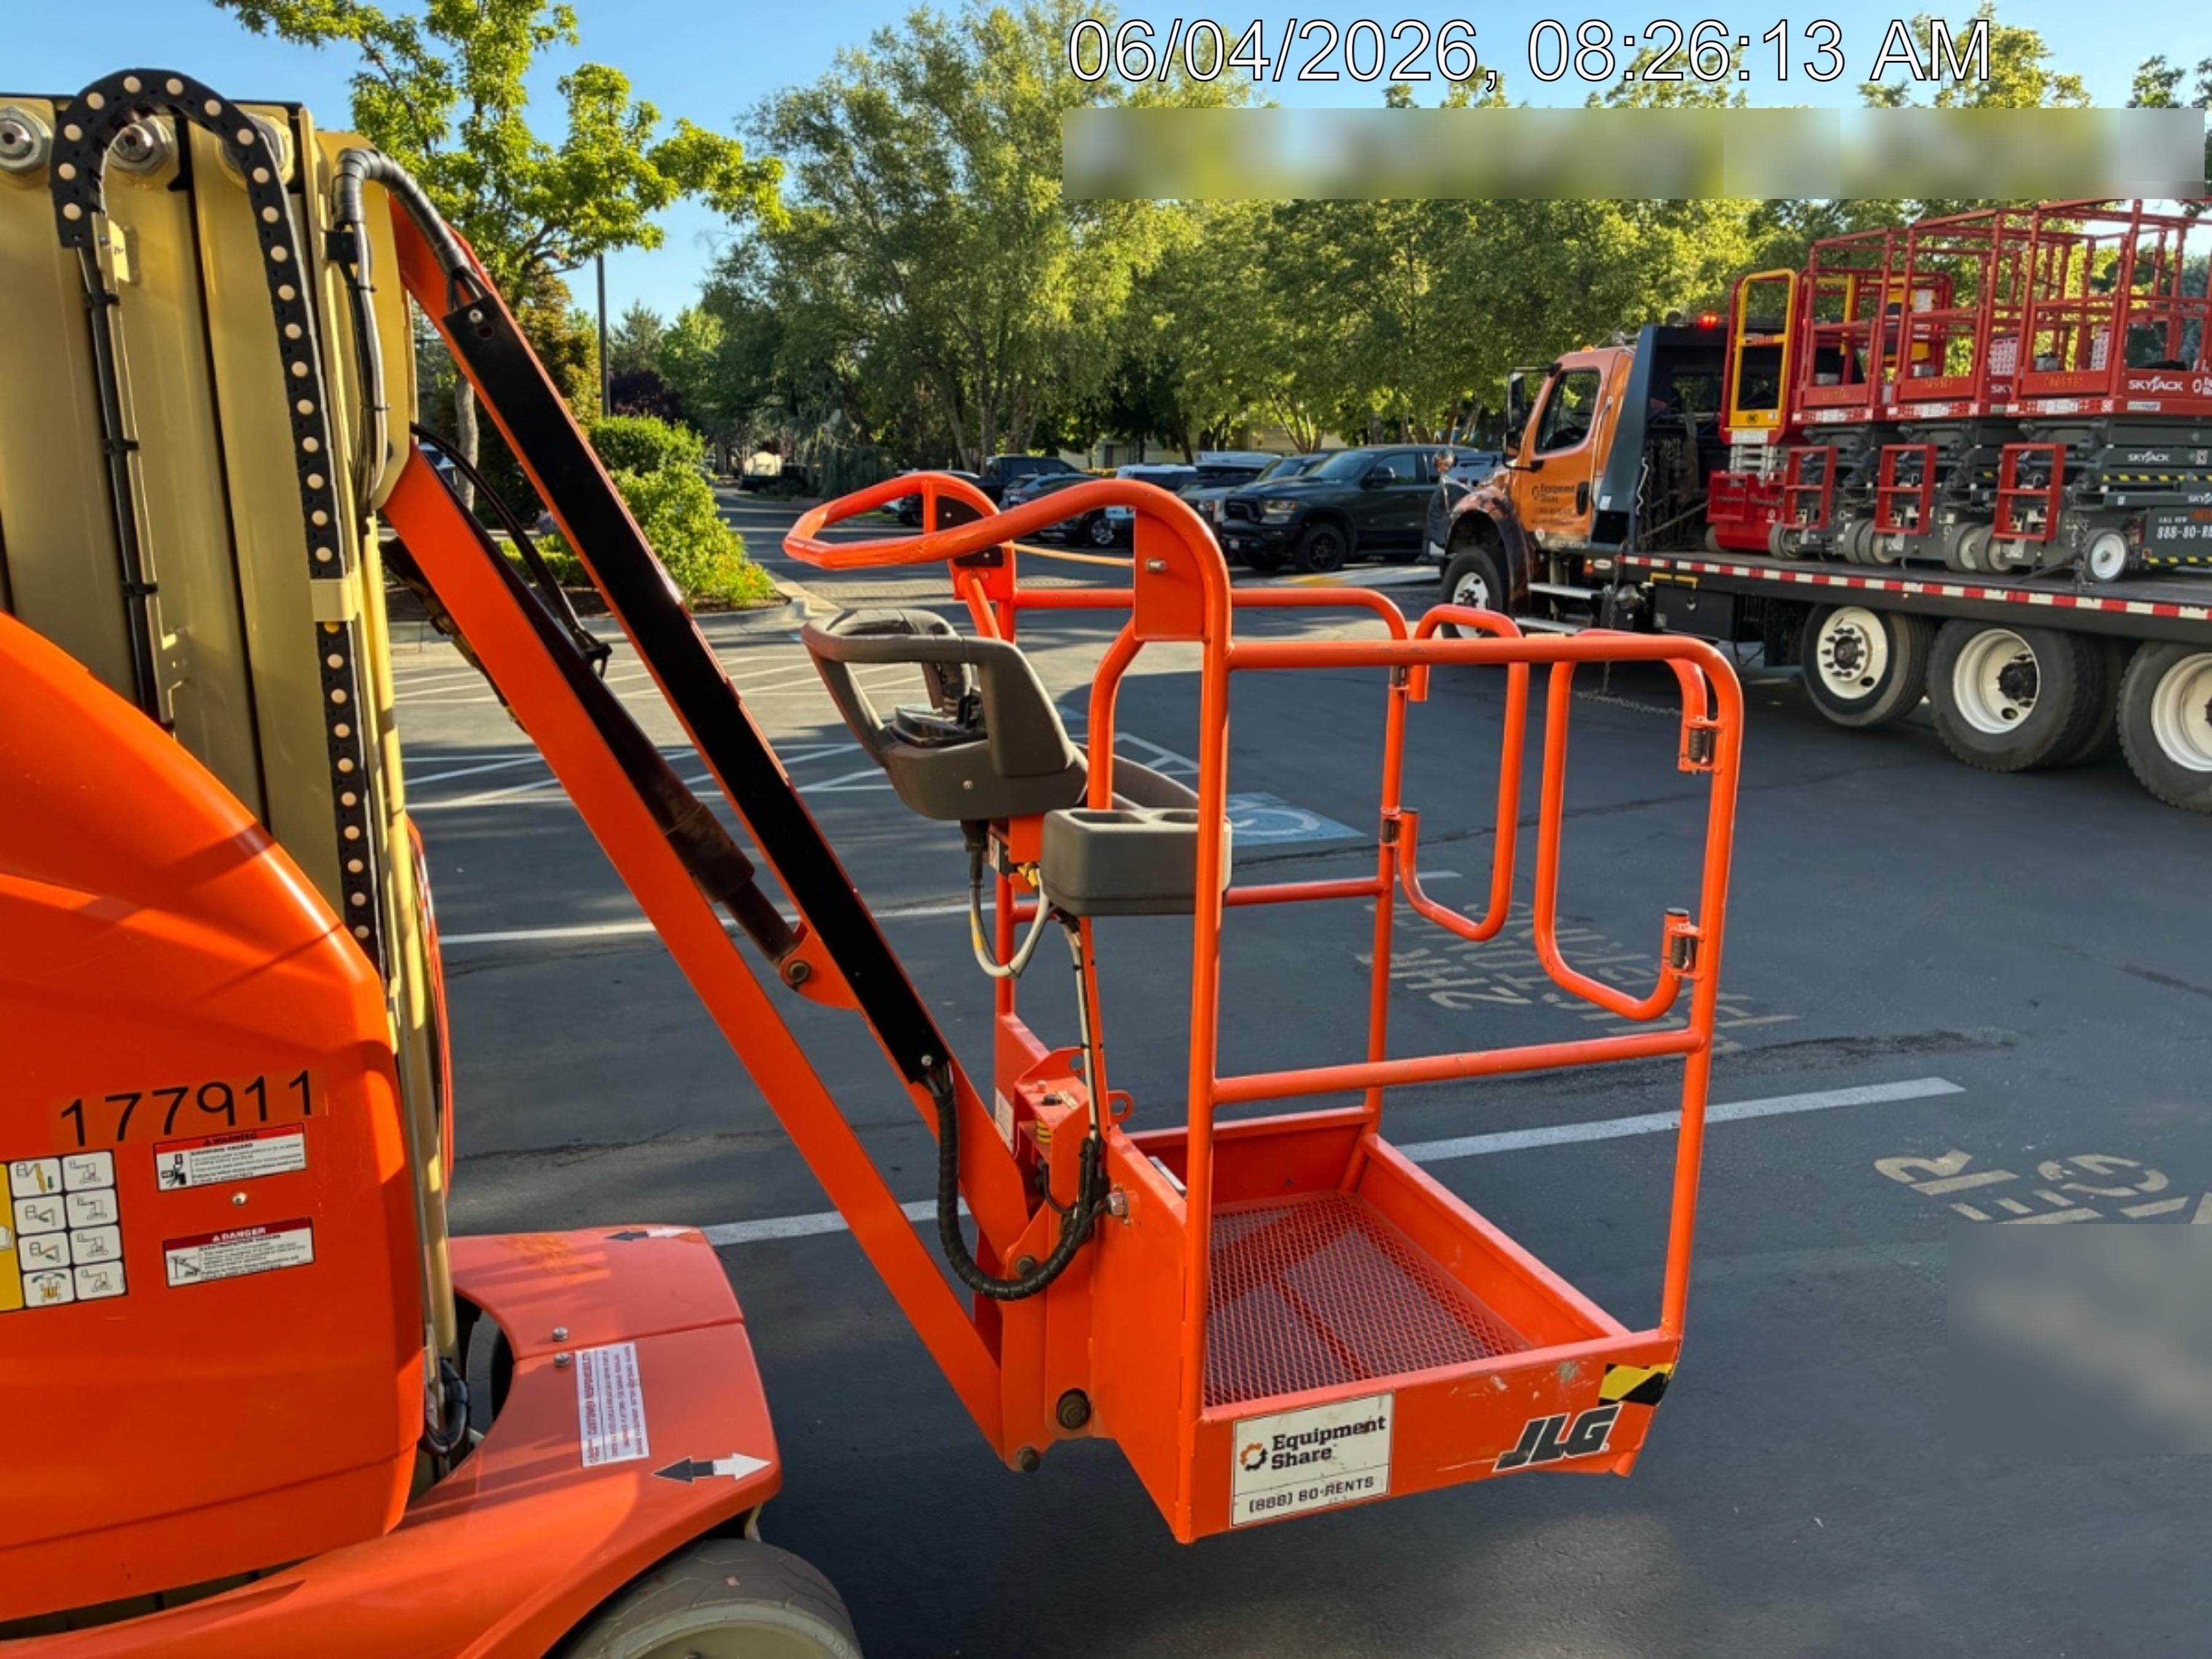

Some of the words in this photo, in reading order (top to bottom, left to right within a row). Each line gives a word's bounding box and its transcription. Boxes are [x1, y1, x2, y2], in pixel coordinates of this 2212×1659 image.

[2128, 375, 2183, 393] SKYJACK
[2128, 450, 2170, 463] SKYJACK
[61, 1070, 312, 1147] 177911
[221, 1227, 267, 1241] DANGER
[1271, 1416, 1386, 1451] Equipment
[1492, 1403, 1623, 1473] JLG
[1271, 1446, 1333, 1470] Share
[1249, 1492, 1293, 1513] (888)
[1298, 1476, 1374, 1502] 80-RENTS
